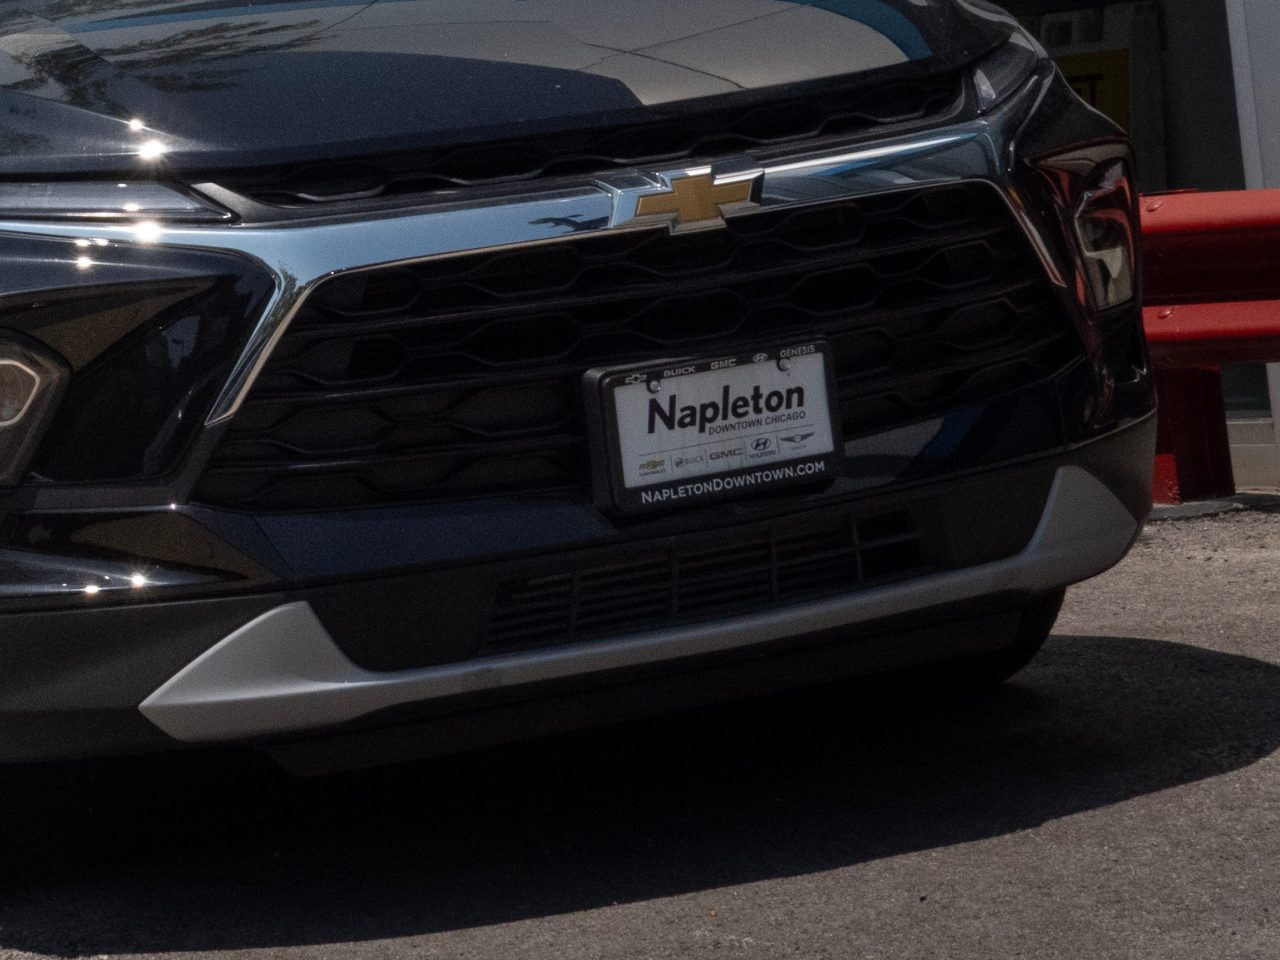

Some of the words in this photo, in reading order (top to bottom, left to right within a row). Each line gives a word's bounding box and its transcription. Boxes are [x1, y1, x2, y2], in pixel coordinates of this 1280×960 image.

[663, 365, 696, 377] BUICK
[710, 358, 737, 370] GMC
[779, 344, 816, 358] GENESIS
[647, 385, 805, 434] Napleton
[708, 418, 763, 436] DOWNTOWN
[764, 410, 806, 426] CHICAGO
[709, 447, 744, 461] GMC
